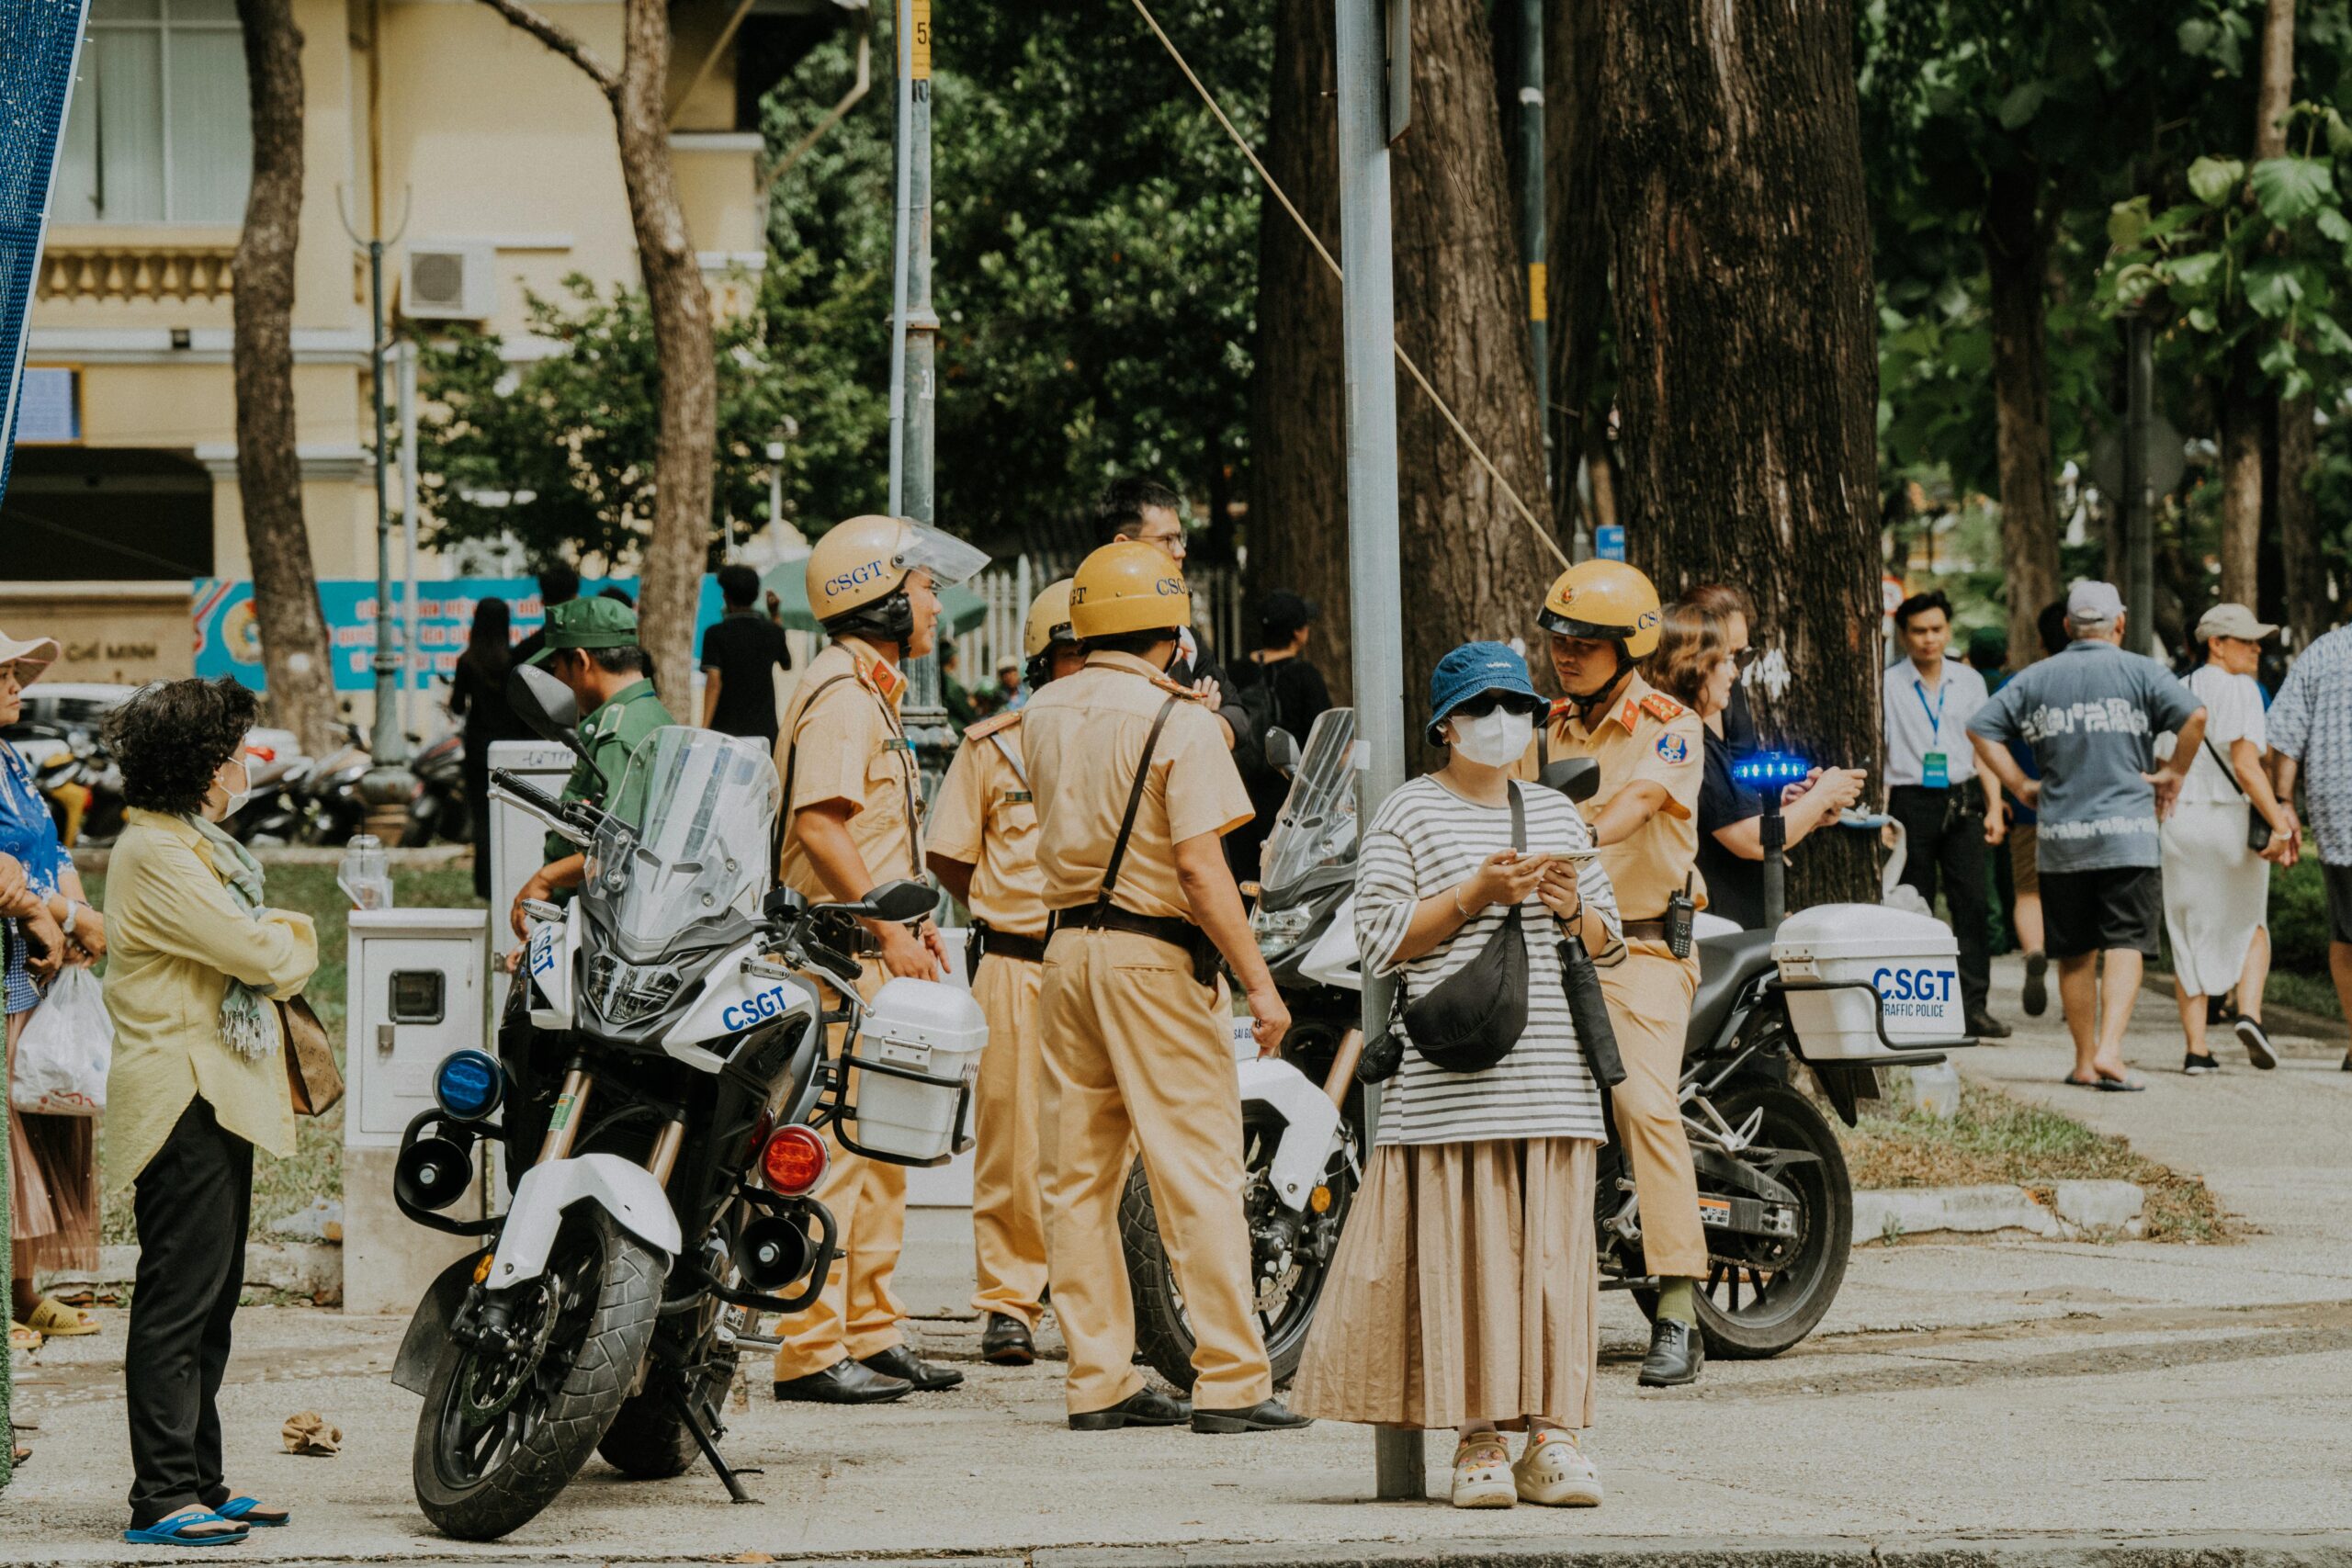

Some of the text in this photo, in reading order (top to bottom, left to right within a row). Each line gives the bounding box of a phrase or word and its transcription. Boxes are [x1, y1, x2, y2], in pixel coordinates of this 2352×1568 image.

[917, 21, 931, 45] 5
[825, 560, 882, 596] CSGT
[1916, 1004, 1944, 1018] POLICE
